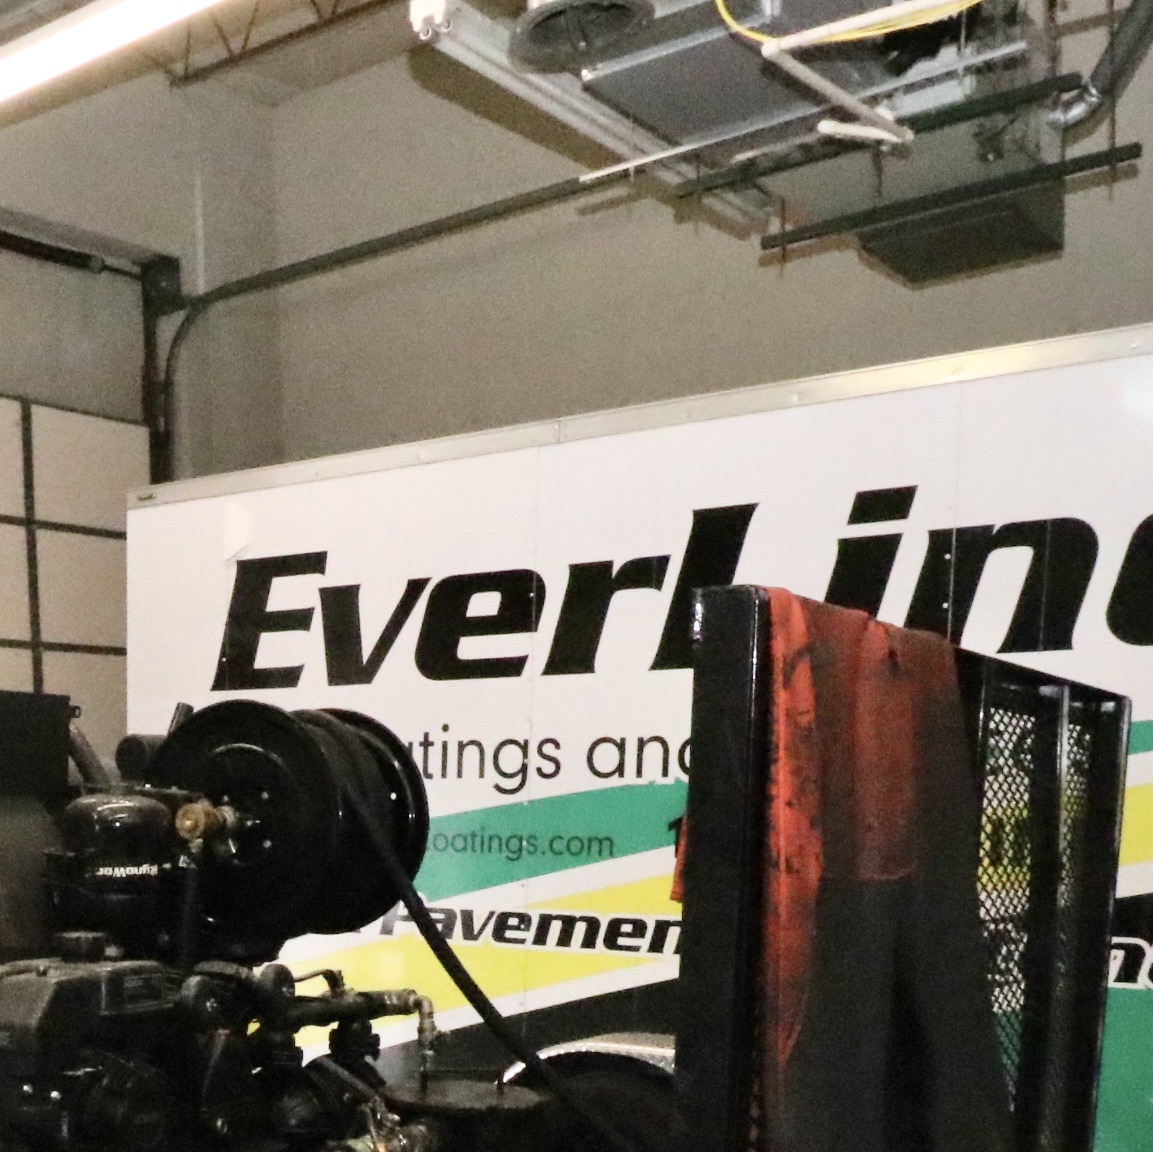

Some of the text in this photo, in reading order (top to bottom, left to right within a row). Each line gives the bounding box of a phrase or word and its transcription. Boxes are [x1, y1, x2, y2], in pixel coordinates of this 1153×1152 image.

[408, 723, 562, 796] tings
[427, 827, 615, 862] oatings.com
[378, 900, 684, 956] Pavemen
